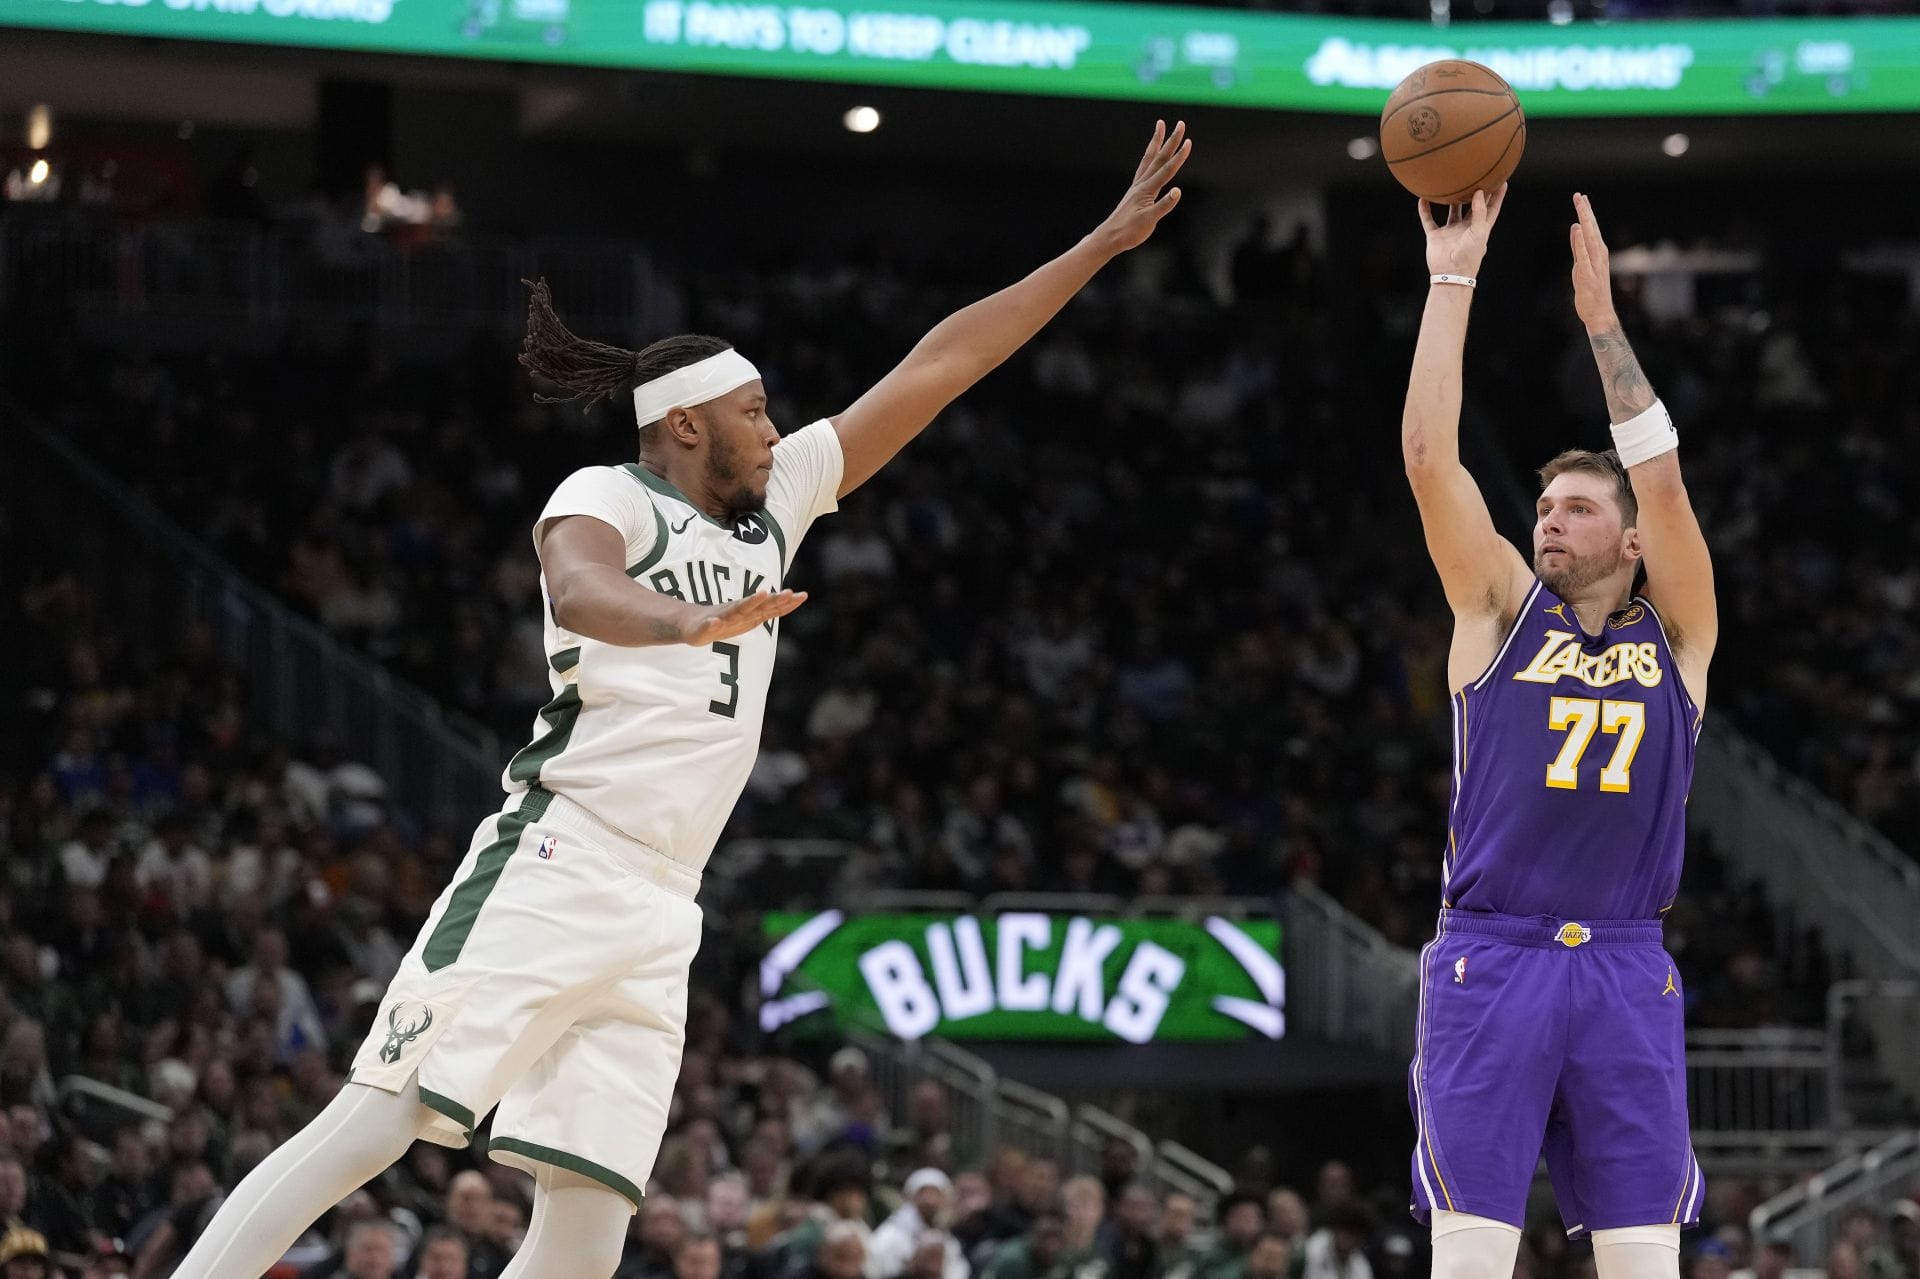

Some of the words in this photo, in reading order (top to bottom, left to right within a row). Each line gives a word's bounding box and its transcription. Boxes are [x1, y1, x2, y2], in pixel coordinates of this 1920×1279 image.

[790, 7, 845, 55] TO
[649, 560, 777, 637] BUCK
[708, 640, 740, 719] 3
[1512, 629, 1663, 688] LAKERS
[1546, 696, 1646, 793] 77
[857, 911, 1187, 1045] BUCKS
